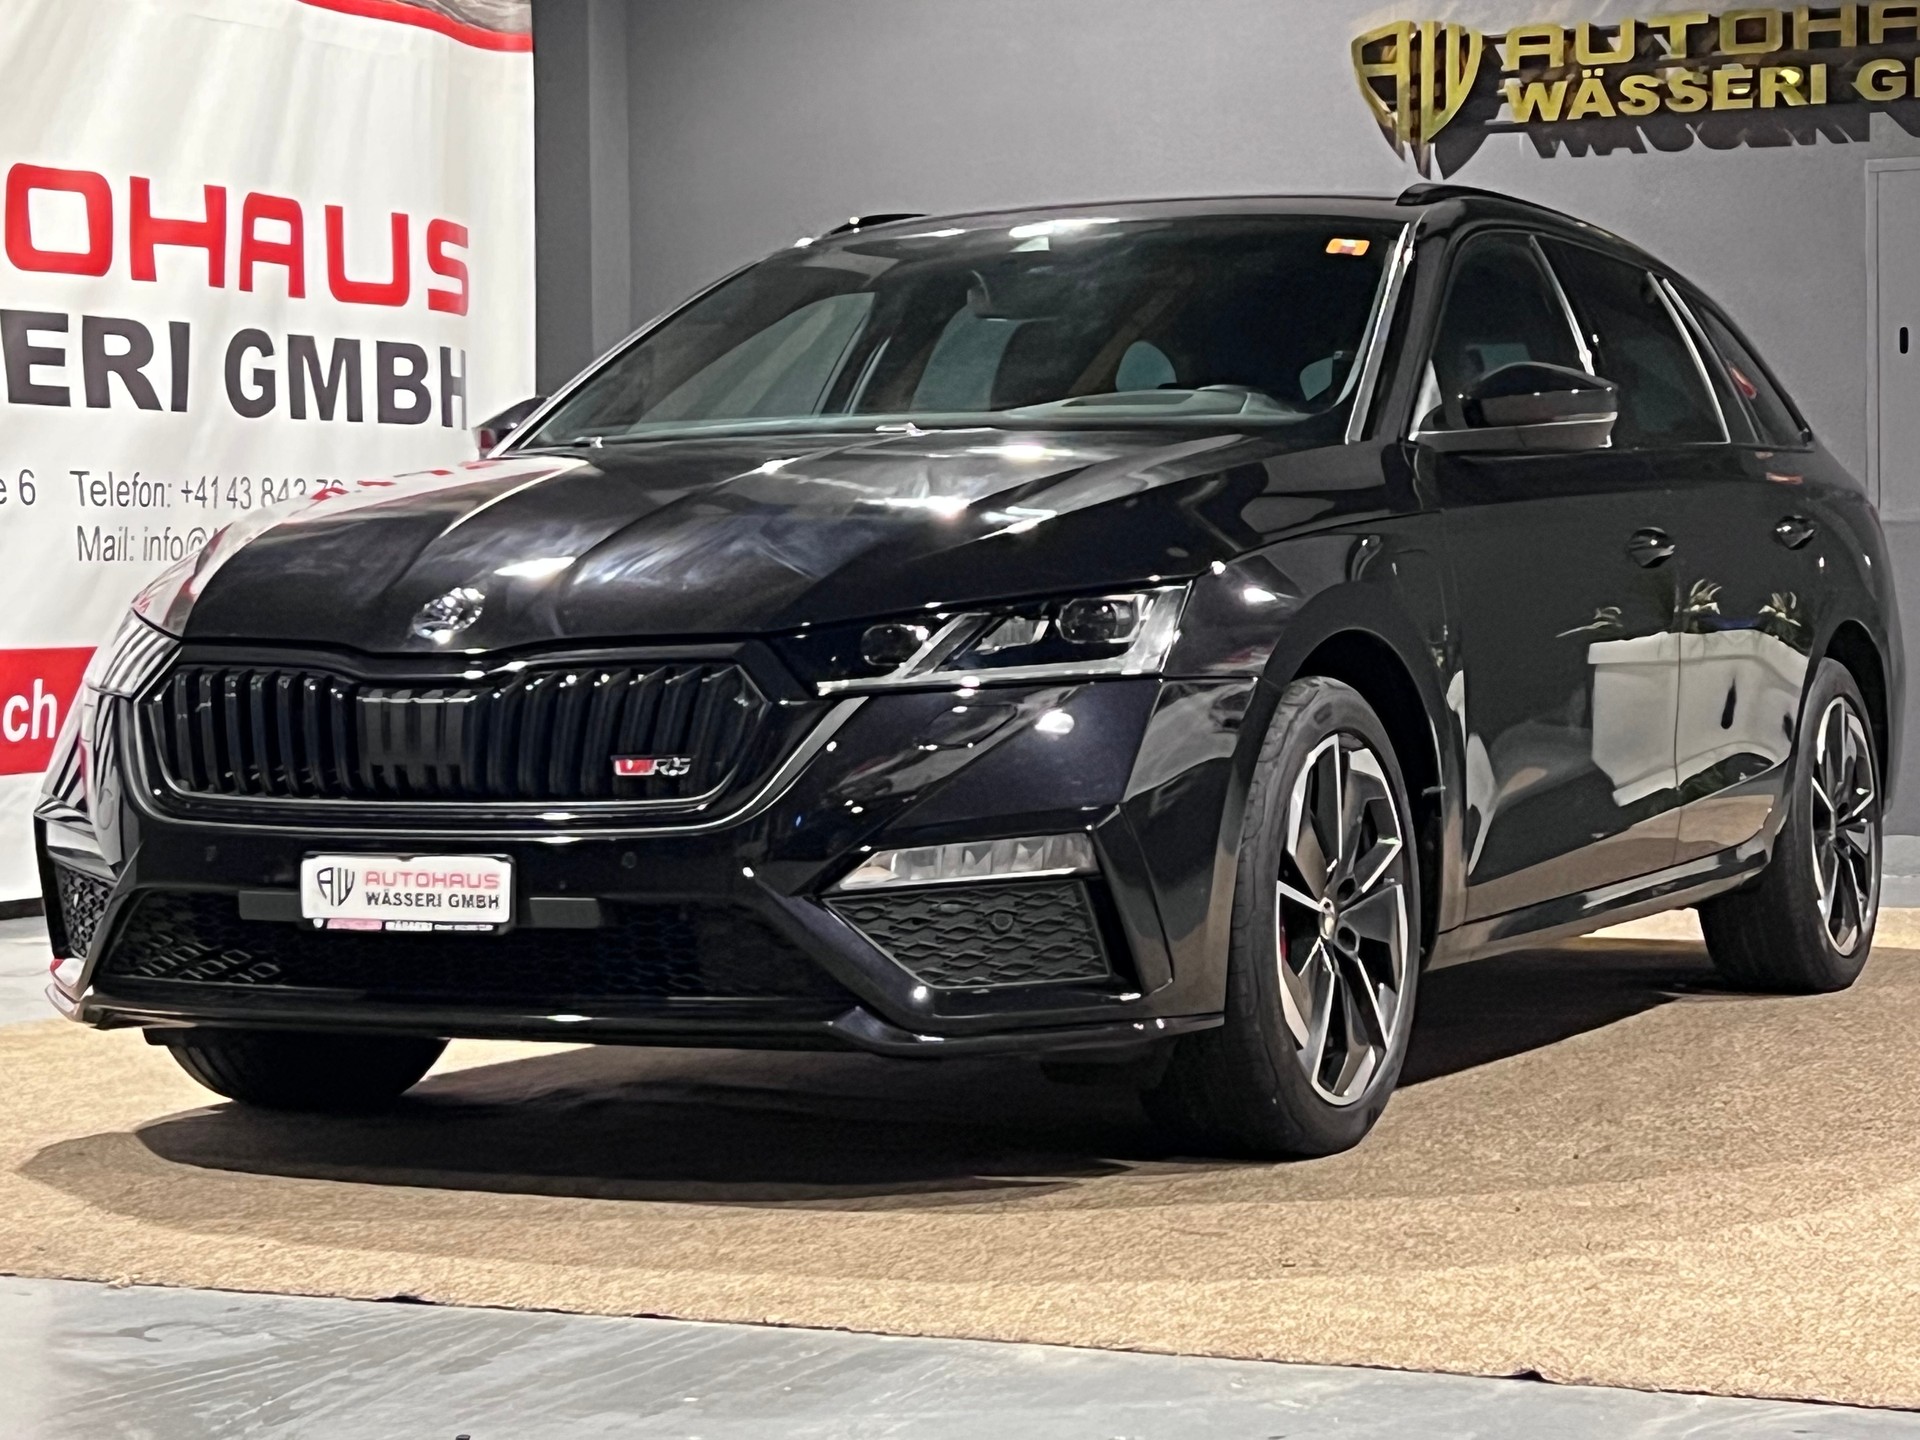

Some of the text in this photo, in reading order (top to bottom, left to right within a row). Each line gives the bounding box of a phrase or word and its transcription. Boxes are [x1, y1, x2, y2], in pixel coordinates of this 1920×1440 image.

[1504, 0, 1920, 71] AUTOHA
[1504, 57, 1920, 123] WÄSSERI G
[5, 162, 469, 317] OHAUS
[0, 308, 468, 431] ERI GMBH
[18, 468, 36, 506] 6
[69, 470, 173, 507] Telefon:
[77, 525, 218, 562] Mail: info@
[365, 870, 501, 890] AUTOHAUS
[365, 889, 501, 910] WÄSSERI GMBH
